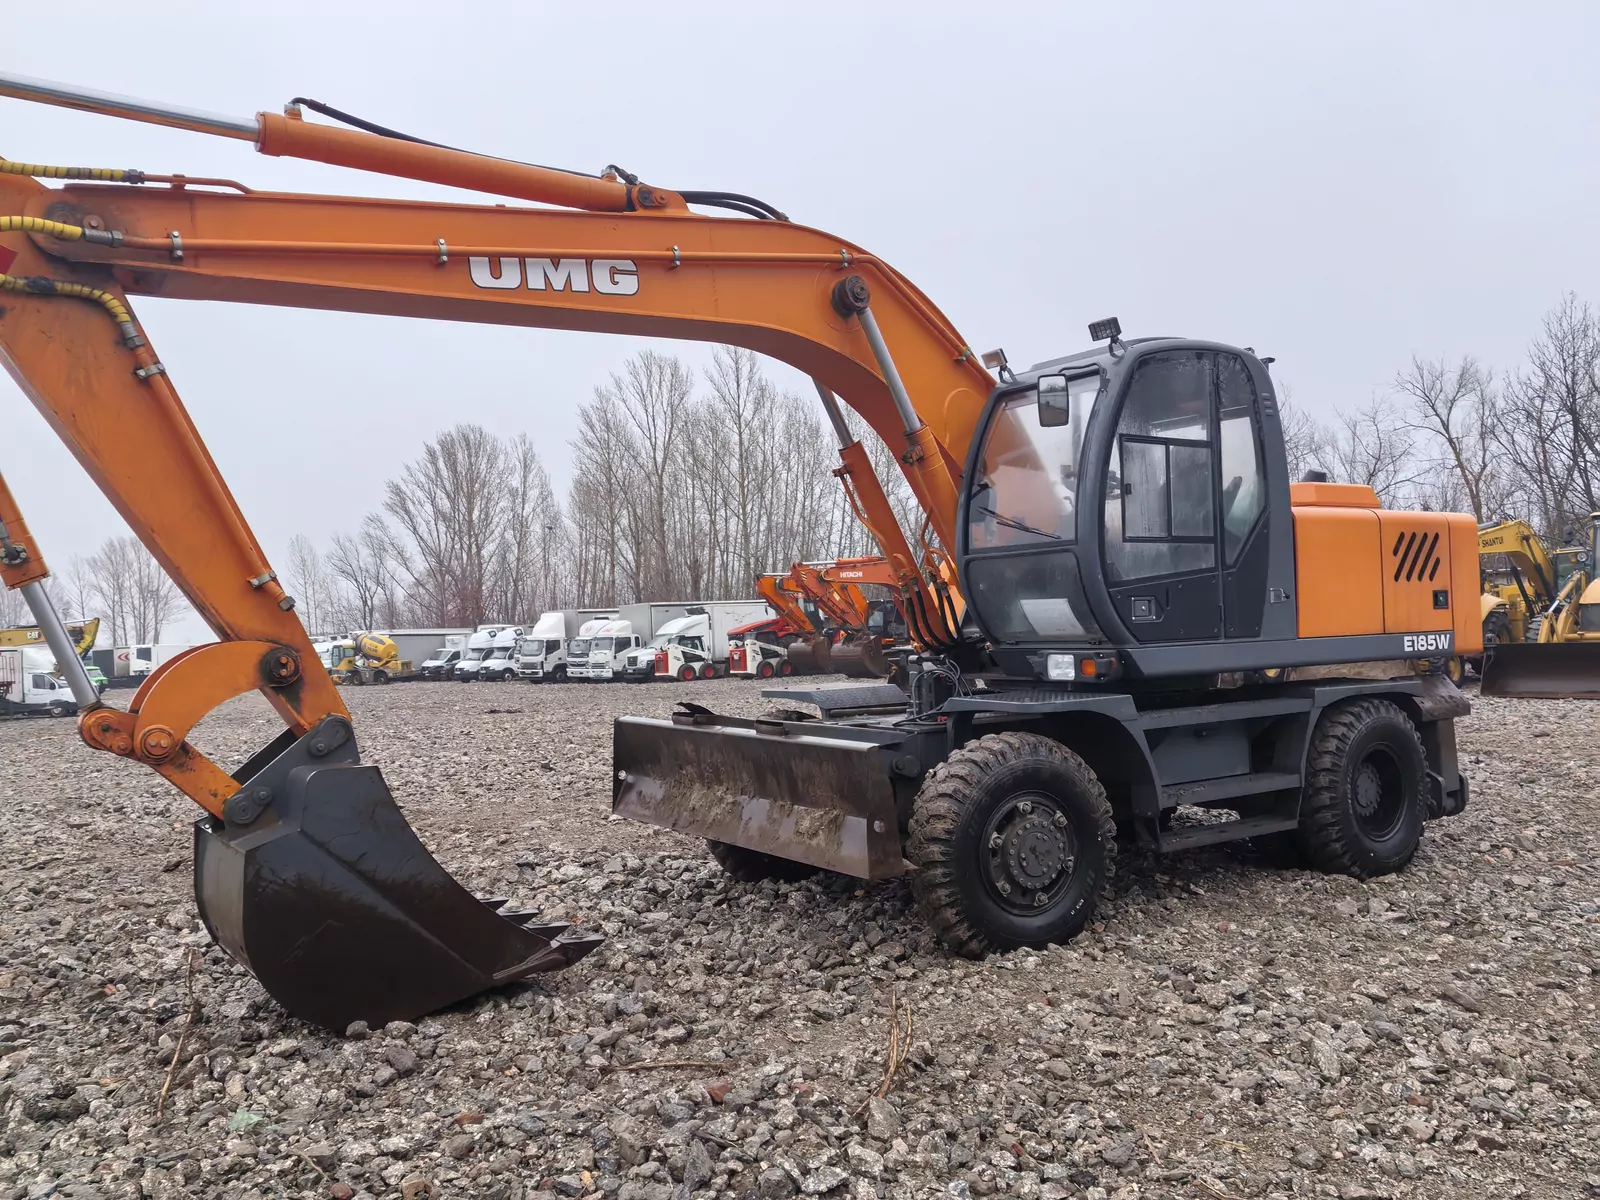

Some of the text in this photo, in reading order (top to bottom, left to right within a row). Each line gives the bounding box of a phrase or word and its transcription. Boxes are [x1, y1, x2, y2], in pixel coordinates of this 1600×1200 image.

[468, 256, 640, 296] UMG
[1482, 536, 1504, 548] SHANTUI
[27, 631, 39, 640] CAT
[1403, 634, 1450, 651] E185W
